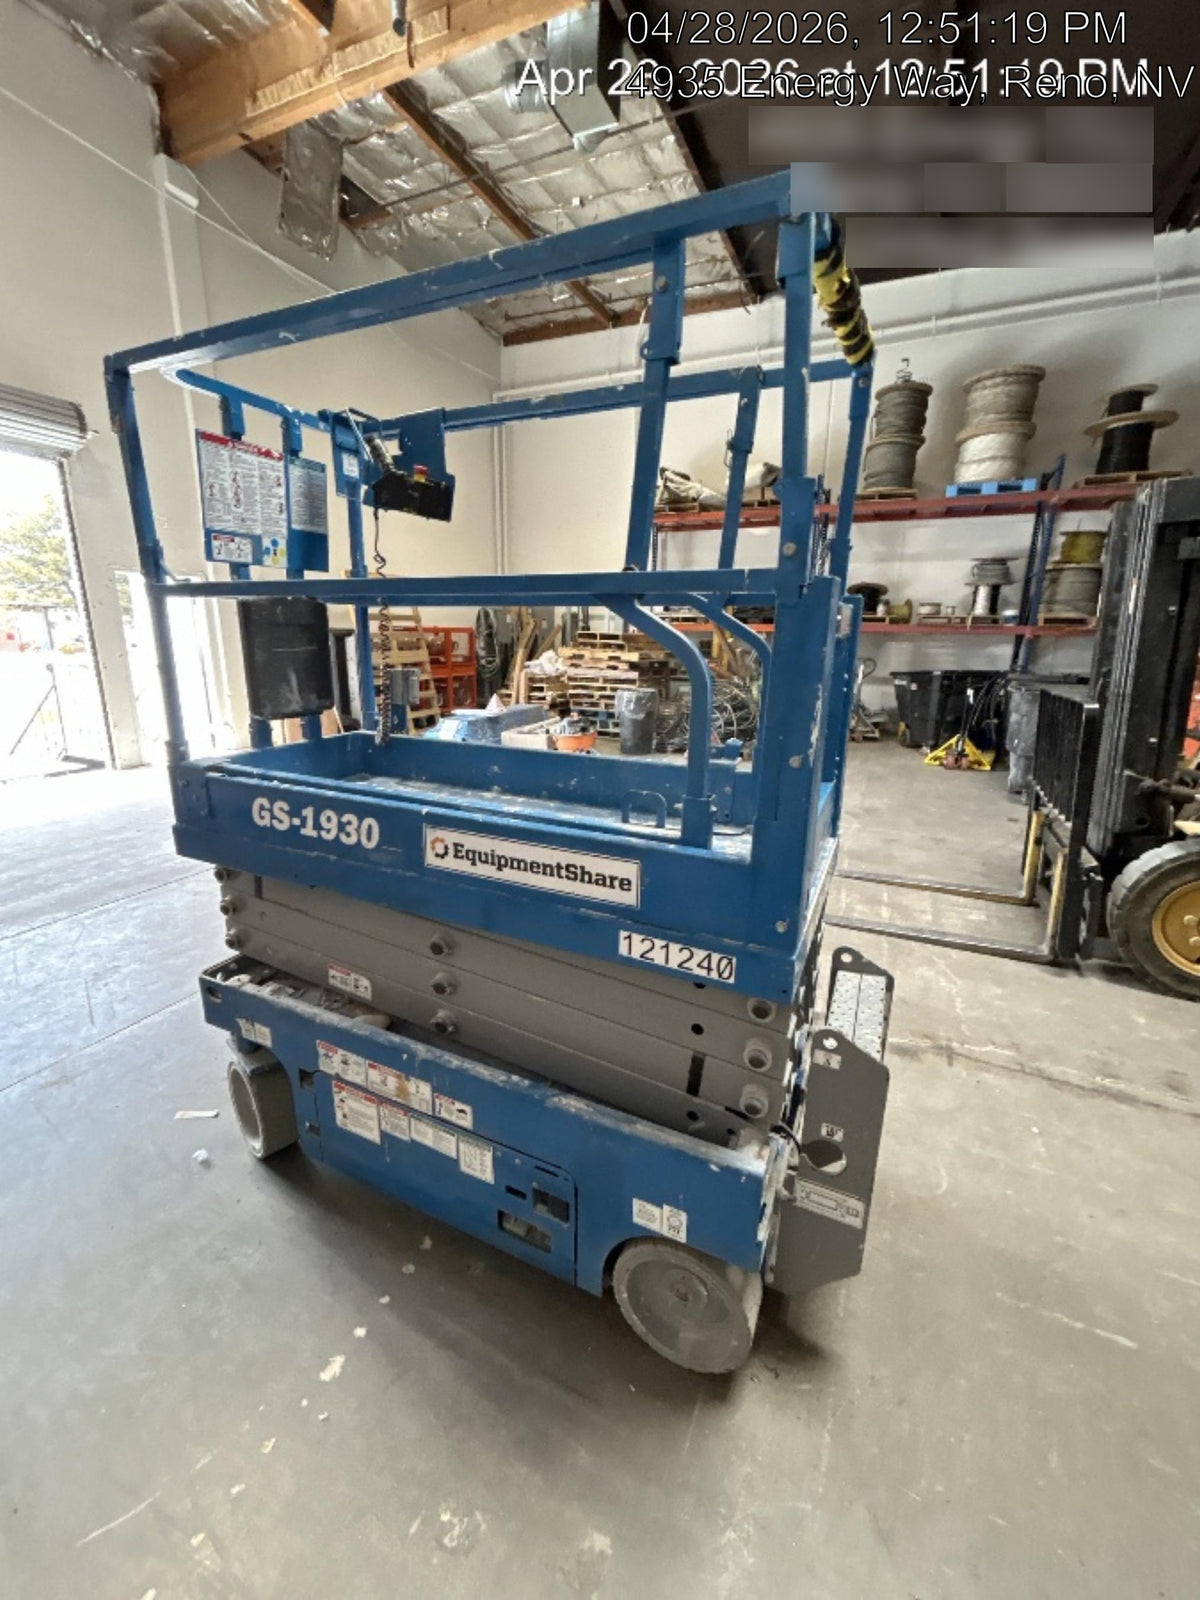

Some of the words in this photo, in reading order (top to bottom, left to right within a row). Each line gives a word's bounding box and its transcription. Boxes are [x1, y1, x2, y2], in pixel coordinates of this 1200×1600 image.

[251, 796, 380, 849] GS-1930
[452, 841, 633, 893] EquipmentShare
[623, 932, 734, 981] 121240
